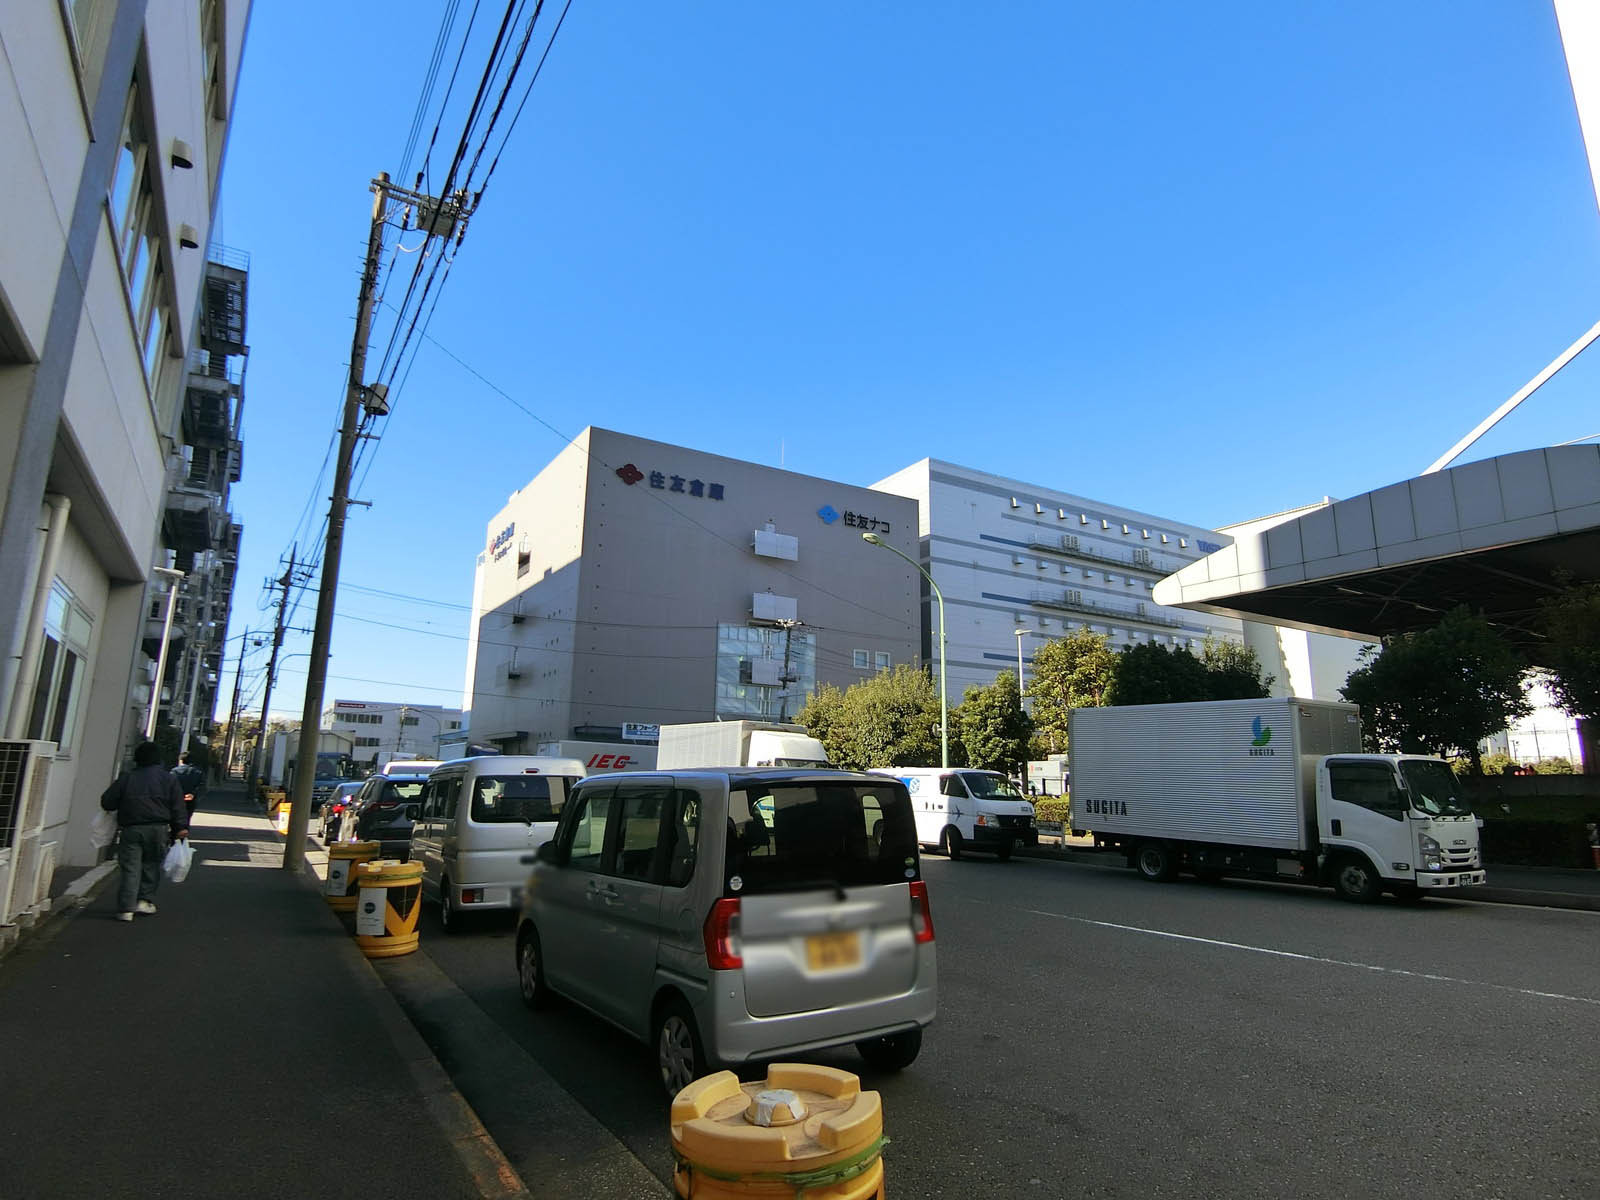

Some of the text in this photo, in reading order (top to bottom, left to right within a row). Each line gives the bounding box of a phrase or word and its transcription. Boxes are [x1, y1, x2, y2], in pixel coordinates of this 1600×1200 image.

[843, 510, 890, 533] 住友ナコ
[1086, 799, 1128, 816] SUGITA
